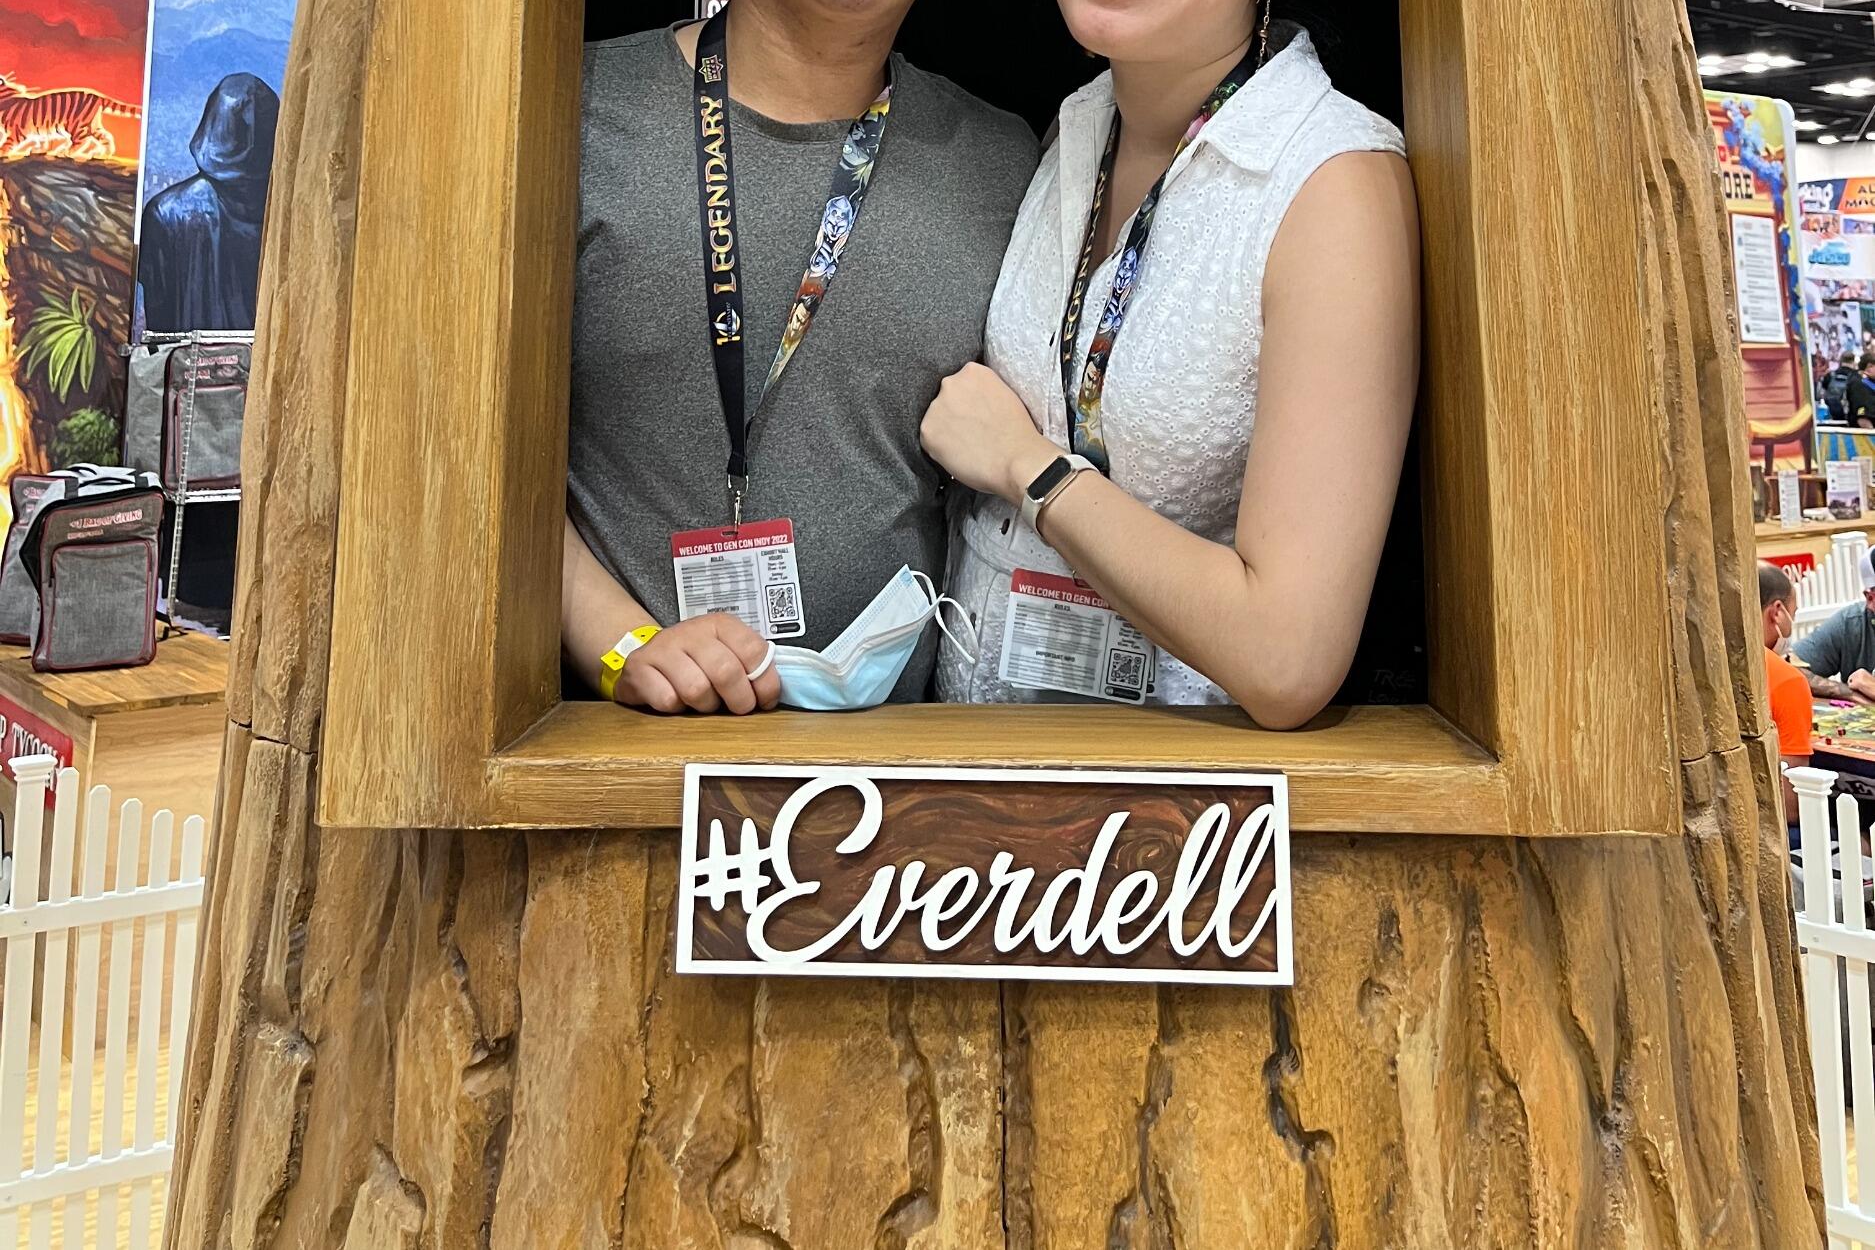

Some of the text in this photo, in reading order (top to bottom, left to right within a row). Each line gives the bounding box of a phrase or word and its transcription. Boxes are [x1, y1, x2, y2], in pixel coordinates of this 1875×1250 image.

[700, 94, 737, 295] LEGENDARY
[679, 534, 789, 556] WELCOME TO GEN CON INDY 2022
[1018, 583, 1060, 600] WELCOME
[1061, 591, 1073, 602] TO
[1073, 593, 1092, 605] GEN
[694, 776, 1277, 963] #Everdell
